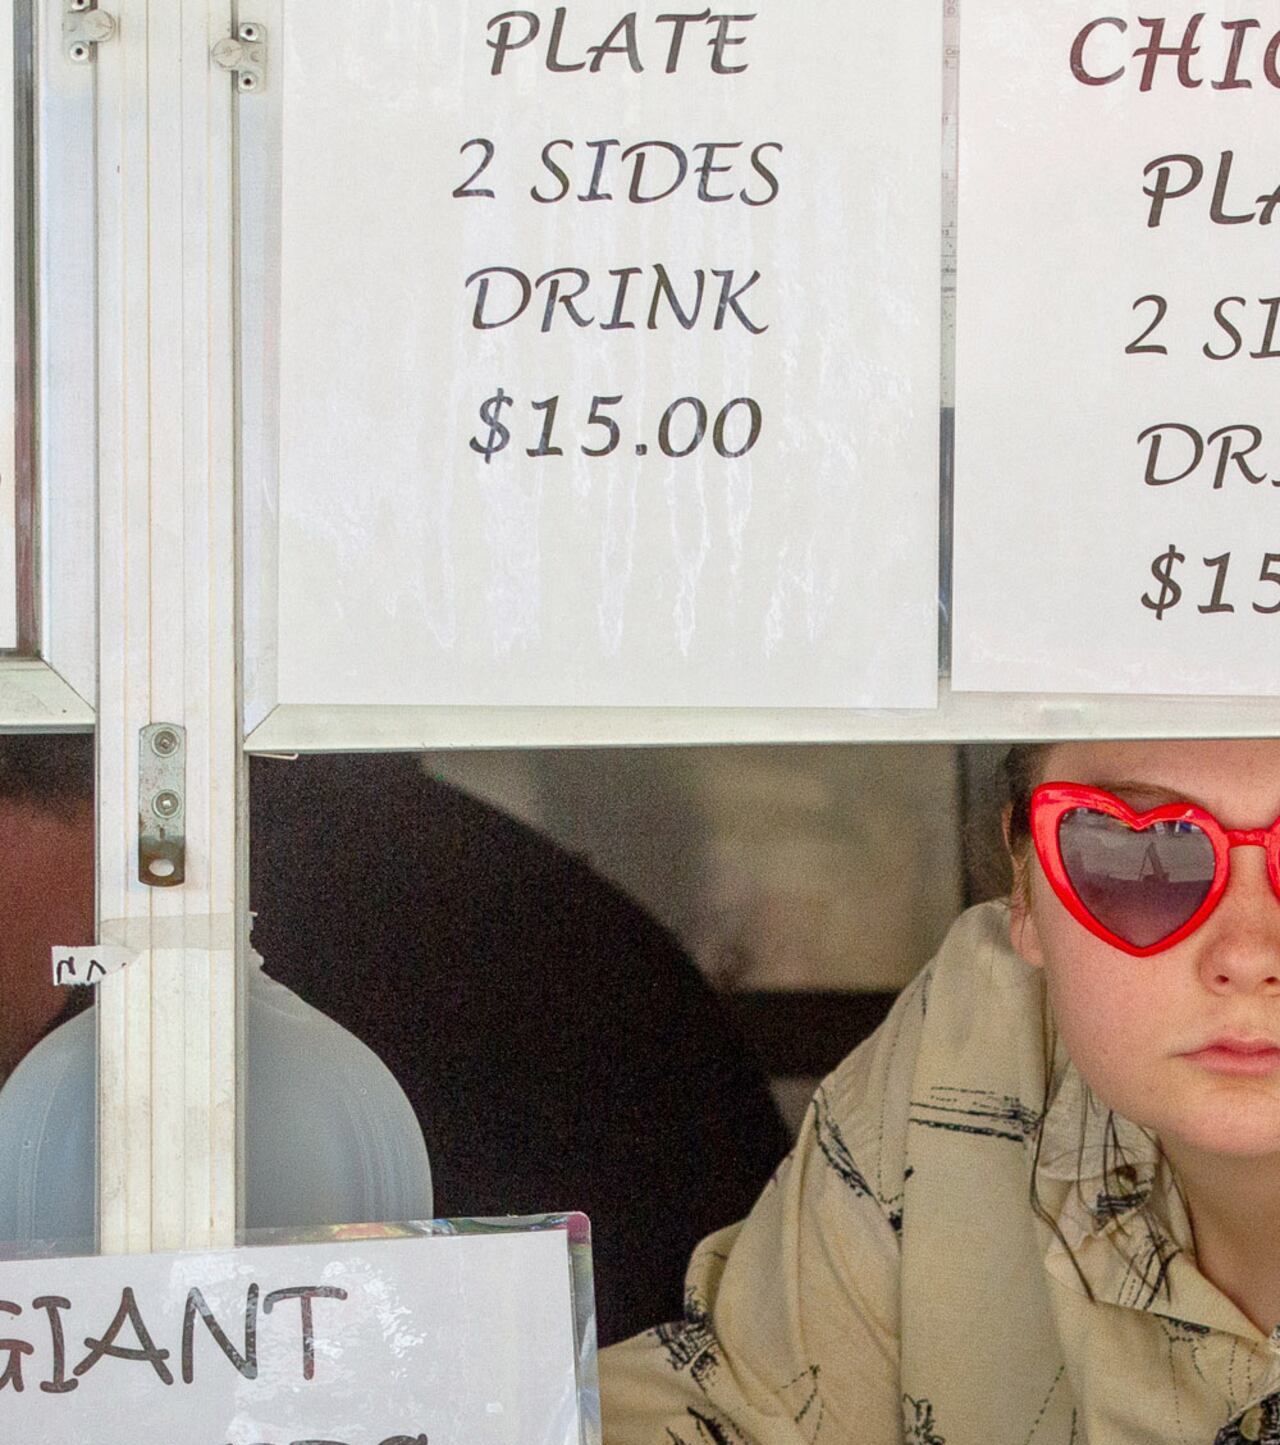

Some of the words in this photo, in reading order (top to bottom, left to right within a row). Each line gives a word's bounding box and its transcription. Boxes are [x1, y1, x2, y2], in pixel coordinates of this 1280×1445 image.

[485, 5, 759, 77] PLATE
[451, 136, 496, 200] 2
[529, 137, 784, 208] SIDES
[463, 262, 770, 336] DRINK
[1123, 293, 1169, 357] 2
[467, 386, 764, 466] $15.00
